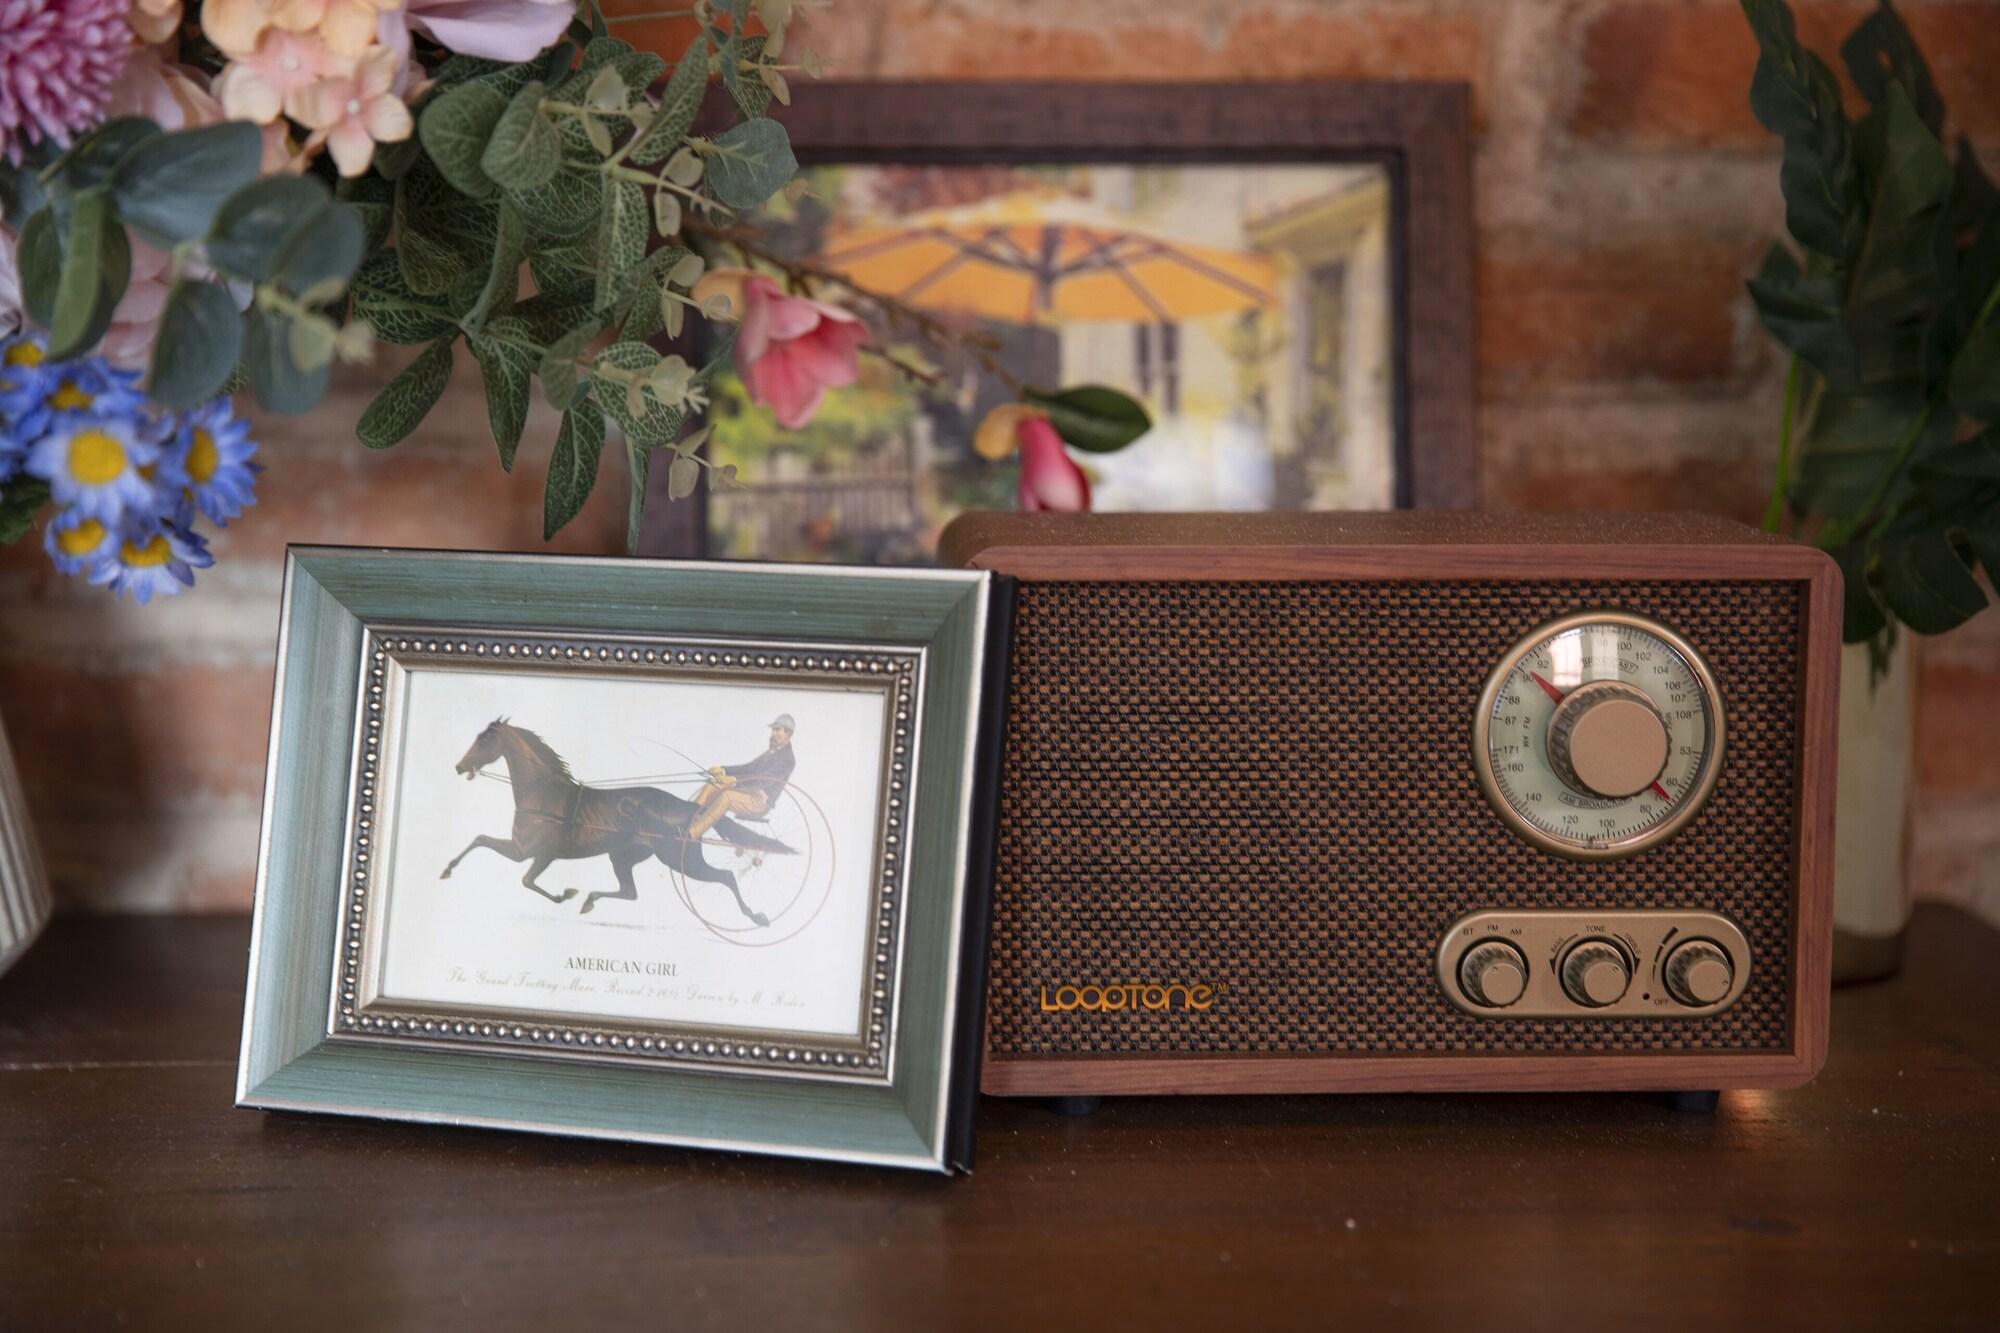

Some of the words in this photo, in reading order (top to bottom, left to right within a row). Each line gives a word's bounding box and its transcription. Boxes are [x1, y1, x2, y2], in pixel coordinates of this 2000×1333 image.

[1635, 651, 1652, 661] 102
[1537, 659, 1550, 669] 92
[1653, 665, 1669, 675] 104
[1665, 681, 1681, 691] 106
[1508, 695, 1521, 705] 88
[1670, 694, 1687, 703] 107
[1675, 709, 1692, 719] 108
[1504, 716, 1517, 725] 87
[1504, 745, 1520, 754] 171
[1679, 746, 1692, 756] 53
[1508, 763, 1525, 773] 160
[1666, 777, 1678, 787] 60
[1525, 792, 1542, 802] 140
[1639, 804, 1652, 814] 80
[1562, 815, 1579, 825] 120
[1599, 818, 1616, 828] 100
[1585, 925, 1605, 933] TONE
[564, 956, 641, 974] AMERICAN
[646, 961, 679, 977] GIRL
